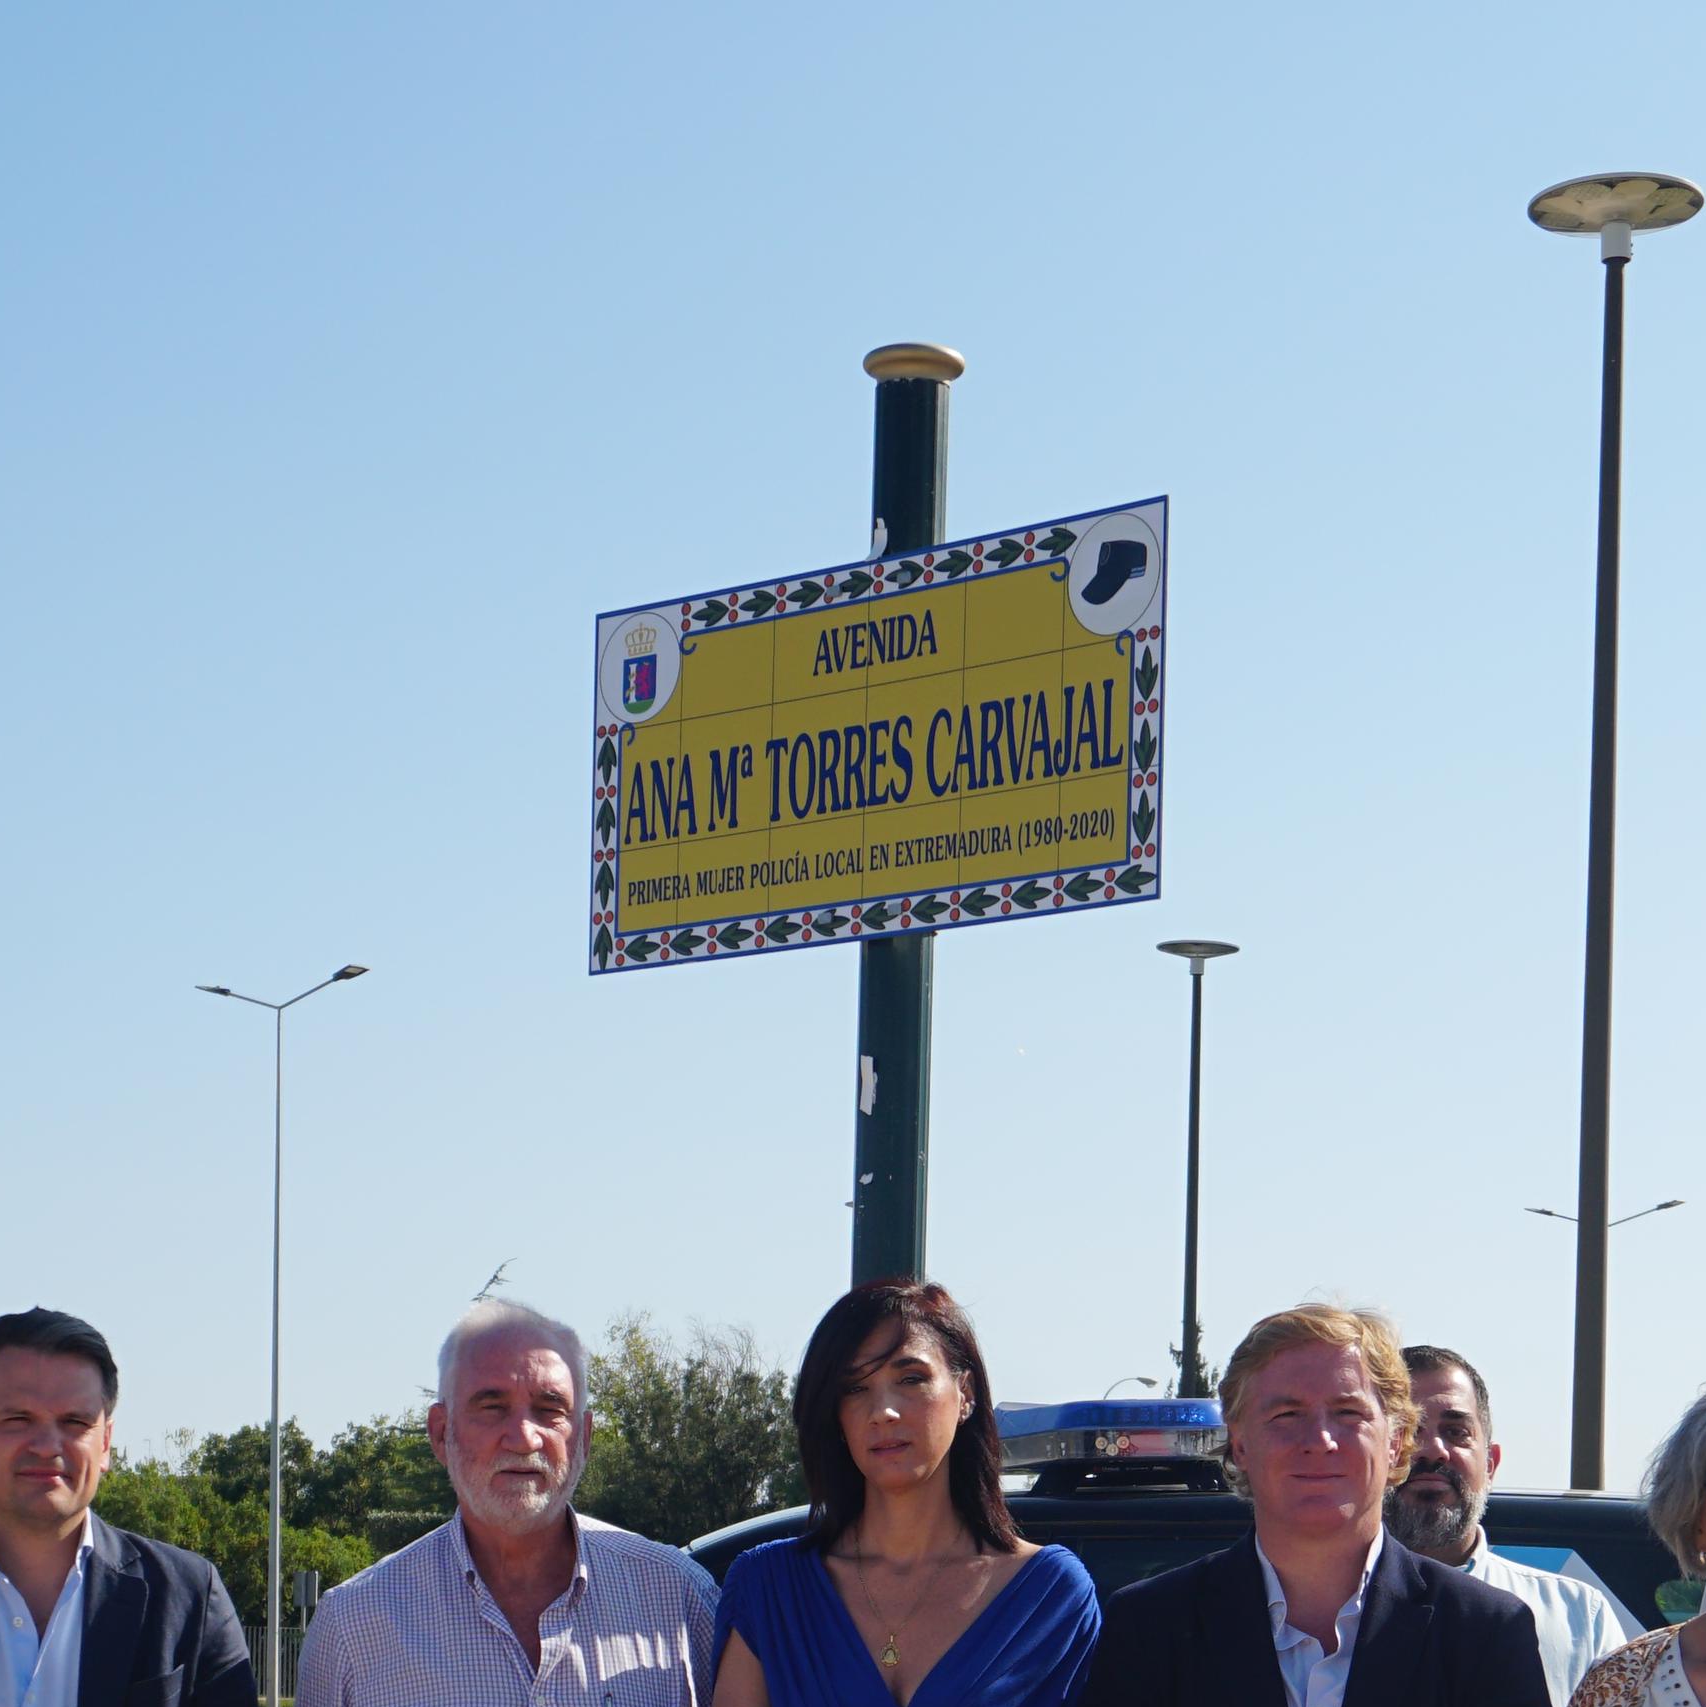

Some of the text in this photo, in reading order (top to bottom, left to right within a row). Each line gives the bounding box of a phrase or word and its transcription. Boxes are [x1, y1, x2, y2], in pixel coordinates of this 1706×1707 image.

[813, 609, 938, 676] AVENIDA
[624, 753, 697, 845] ANA
[765, 715, 913, 823] TORRES
[926, 678, 1124, 798] CARVAJAL
[628, 807, 1115, 906] PRIMERA MUJER POLICÍA LOCAL EN EXTREMADURA (1980-2020)
